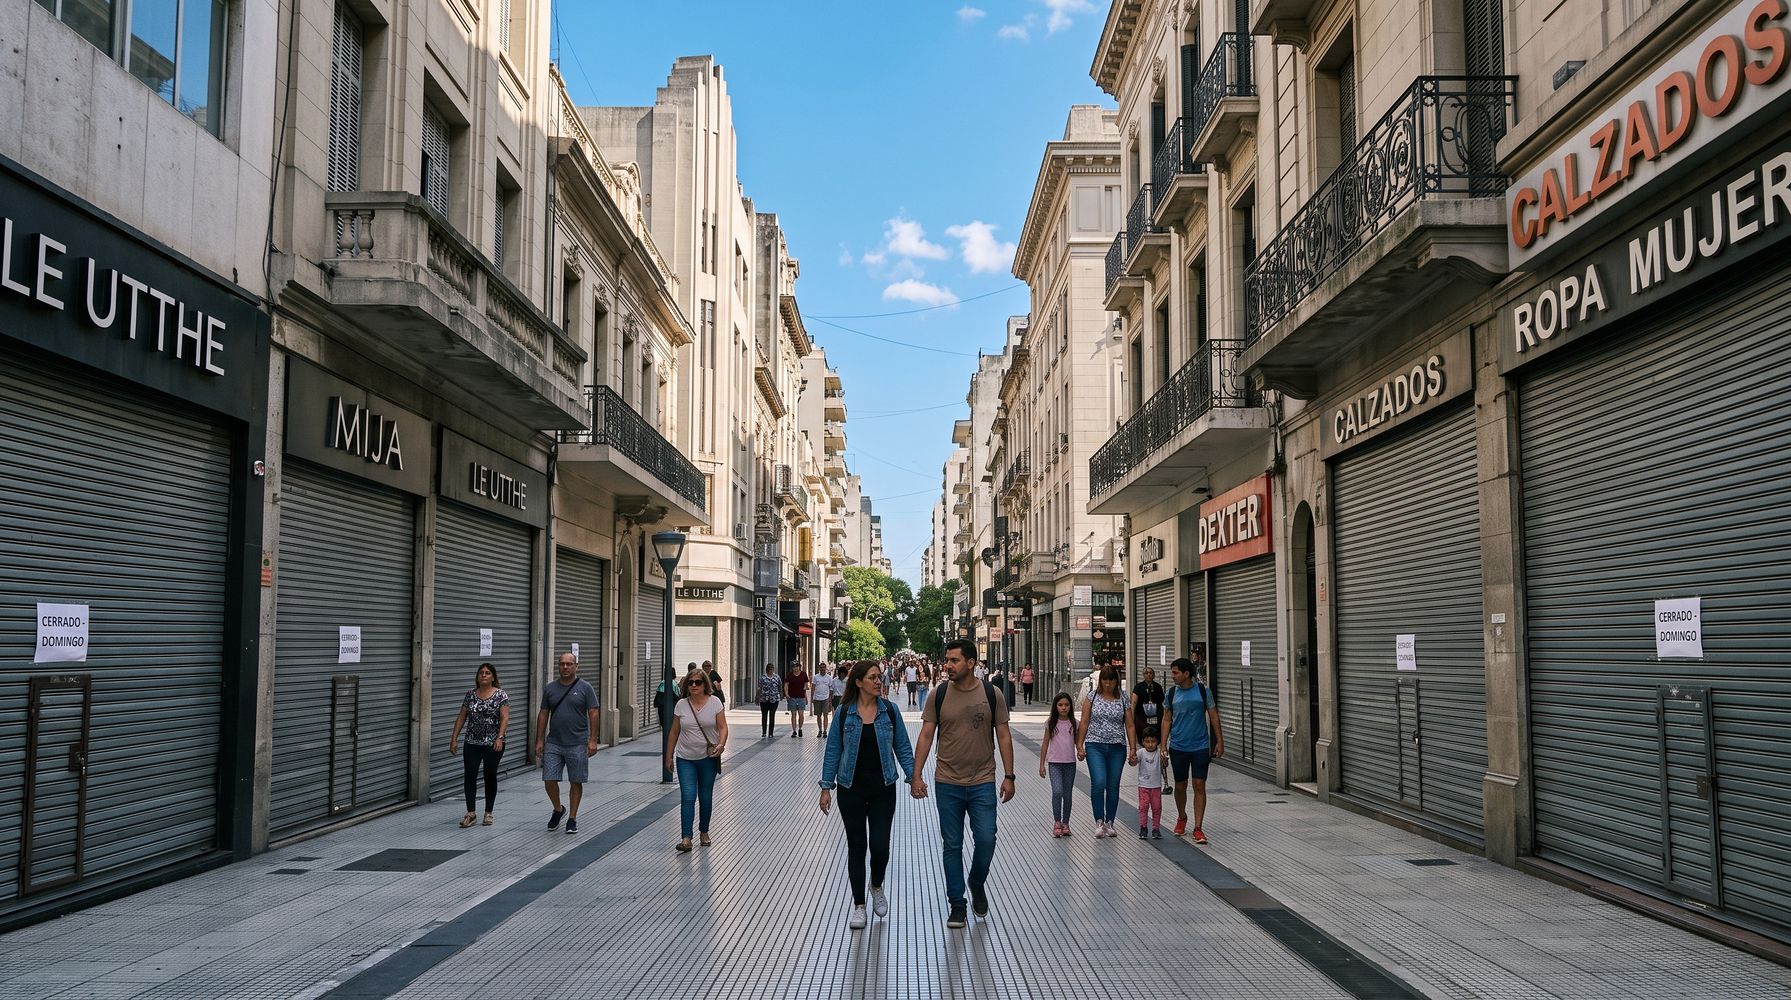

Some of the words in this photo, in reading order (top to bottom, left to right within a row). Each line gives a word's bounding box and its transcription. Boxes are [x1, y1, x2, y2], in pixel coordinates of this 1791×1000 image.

[1511, 0, 1787, 249] CALZADOS
[1514, 263, 1607, 354] ROPA
[1628, 150, 1791, 295] MUJER
[1, 217, 67, 311] LE
[86, 256, 226, 377] UTTHE
[1334, 355, 1442, 444] CALZADOS
[333, 396, 404, 471] MIJA
[472, 461, 488, 497] LE
[490, 468, 527, 511] UTTHE
[1198, 494, 1260, 555] DEXTER
[677, 588, 690, 598] LE
[692, 588, 724, 599] UTTHE
[1658, 610, 1693, 623] CERRADO
[41, 615, 81, 628] CERRADO
[41, 636, 85, 647] DOMINGO
[1660, 630, 1697, 642] DOMINGO
